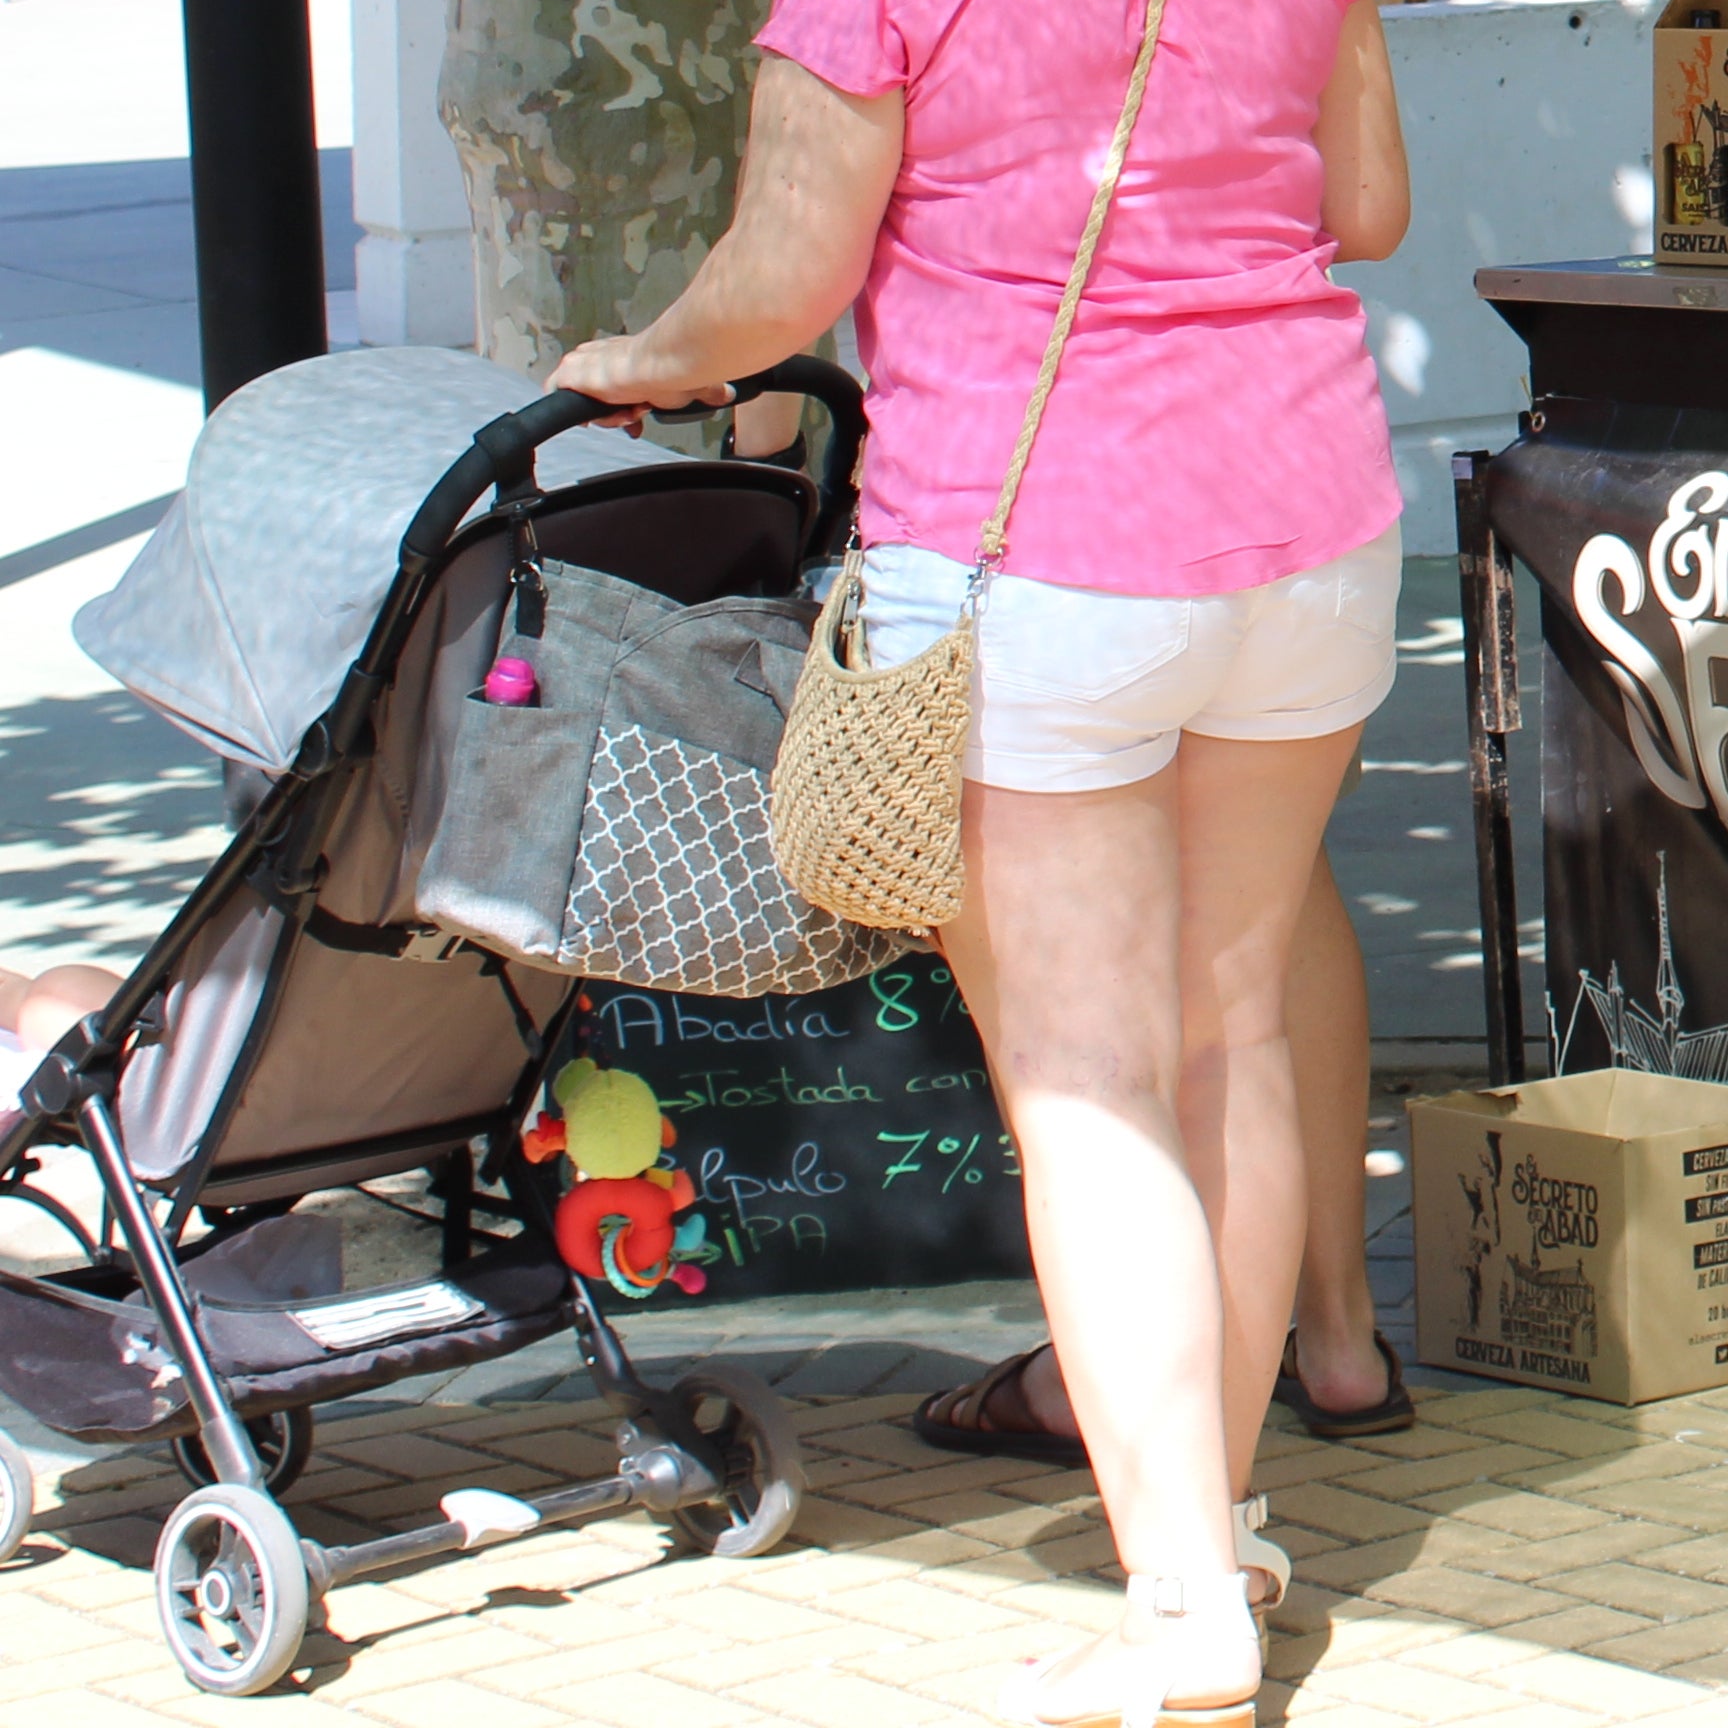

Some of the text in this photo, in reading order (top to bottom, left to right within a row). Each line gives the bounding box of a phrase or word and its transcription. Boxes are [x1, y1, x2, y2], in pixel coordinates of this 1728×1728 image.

[1660, 232, 1728, 255] CERVEZA
[598, 993, 851, 1051] Abadía
[680, 1065, 987, 1110] Tostada con
[1512, 1163, 1598, 1215] SECRETO
[1706, 1174, 1719, 1192] SIN
[1696, 1198, 1711, 1217] SIN
[1538, 1208, 1599, 1250] ABAD
[1697, 1272, 1706, 1290] DE
[1708, 1305, 1719, 1322] 20
[1455, 1335, 1591, 1384] CERVEZA ARTESANA
